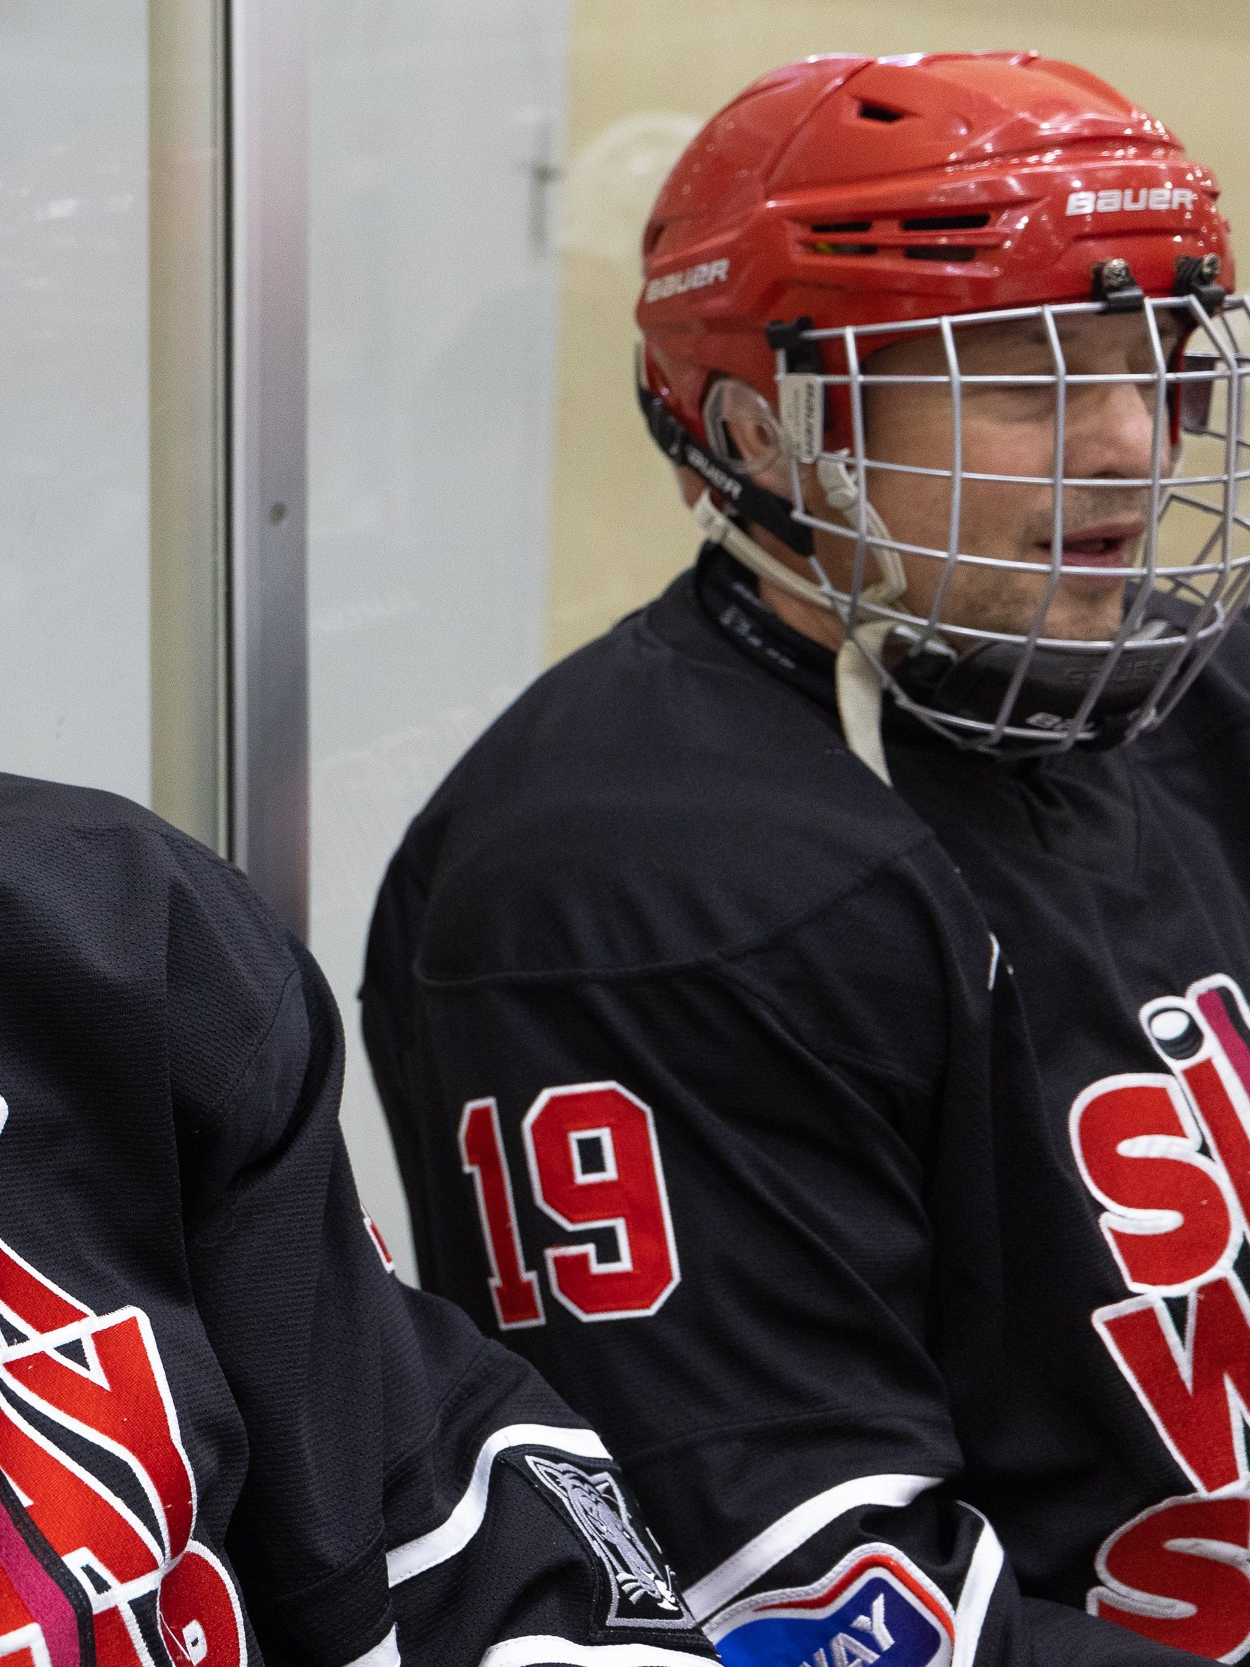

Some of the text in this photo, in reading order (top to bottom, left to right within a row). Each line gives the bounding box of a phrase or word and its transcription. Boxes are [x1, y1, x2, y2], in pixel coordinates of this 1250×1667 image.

[1065, 187, 1194, 217] BAUER
[458, 1081, 681, 1330] 19
[788, 1592, 896, 1667] AY
